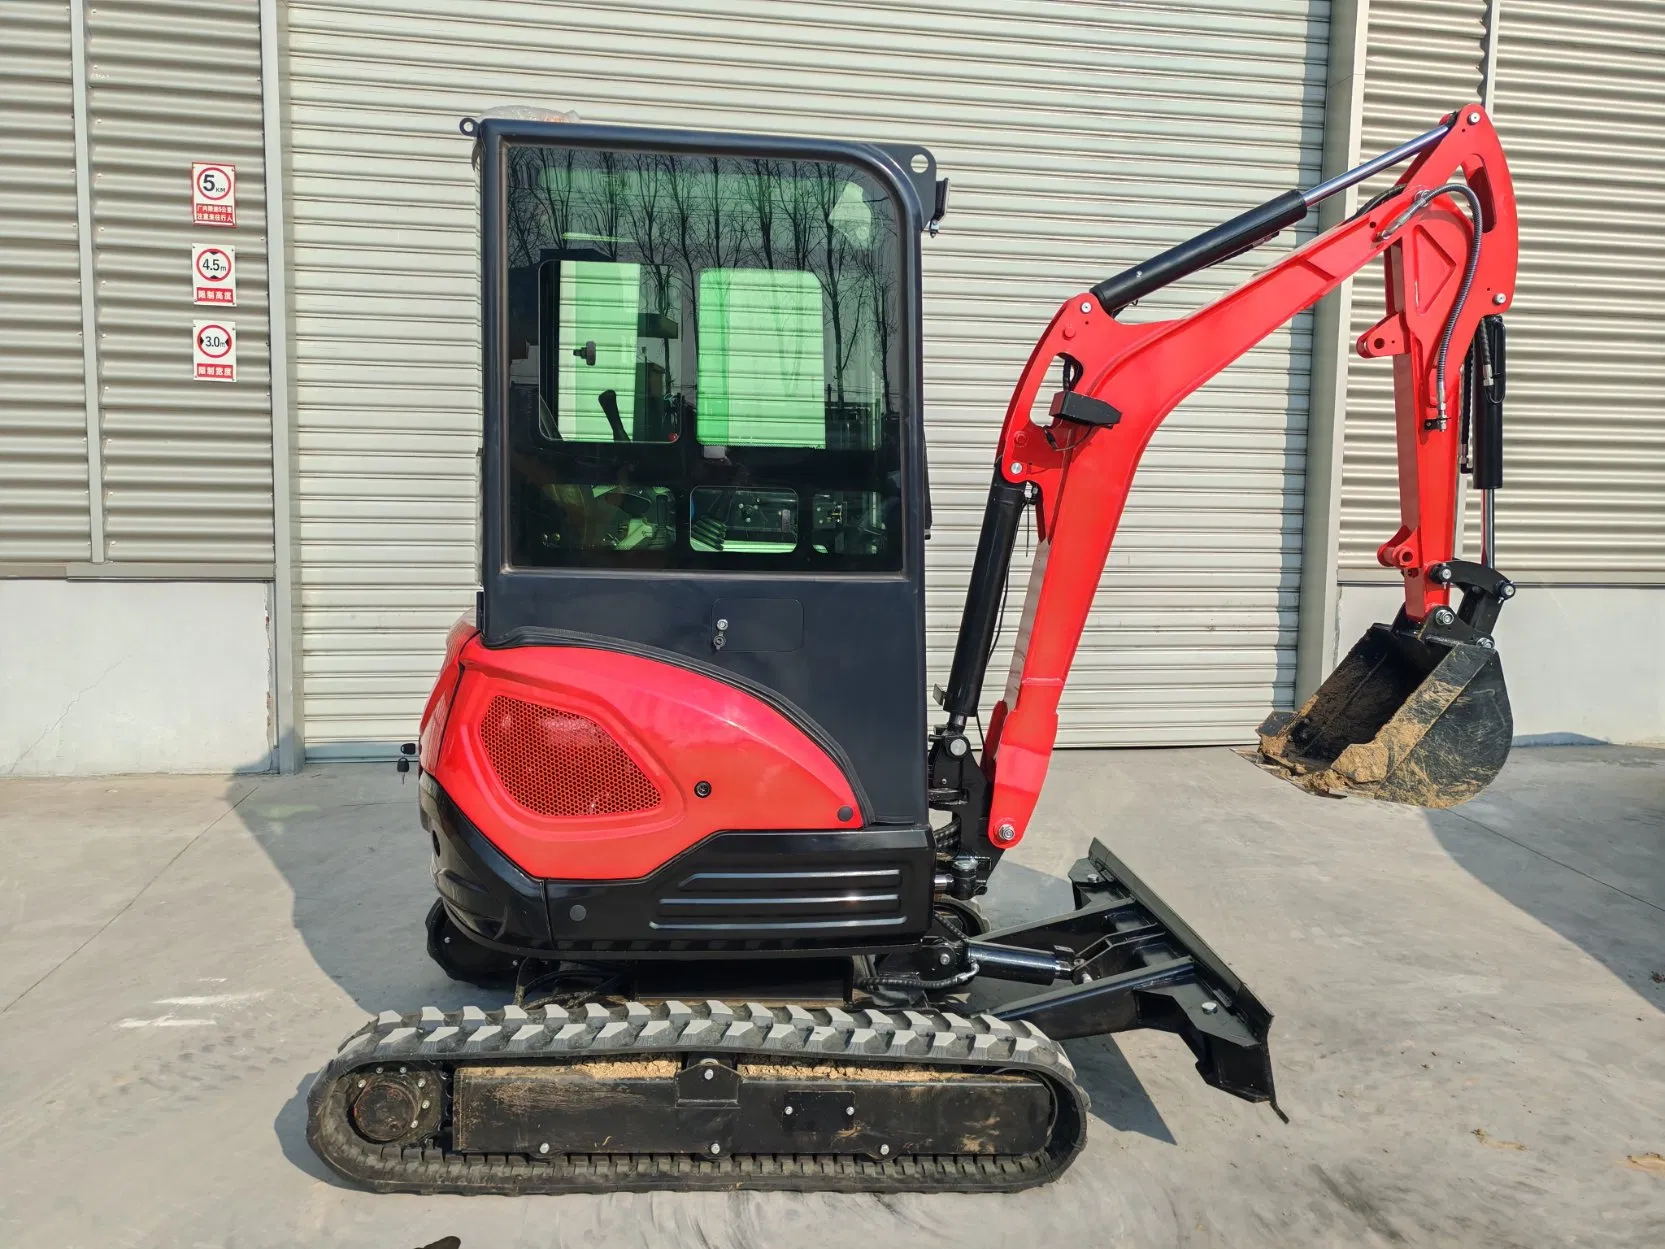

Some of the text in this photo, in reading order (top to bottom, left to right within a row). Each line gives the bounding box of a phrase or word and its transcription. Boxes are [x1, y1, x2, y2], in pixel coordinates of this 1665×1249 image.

[202, 258, 226, 272] 4.5m
[198, 290, 232, 300] 限制高度
[198, 366, 232, 376] 限制宽度
